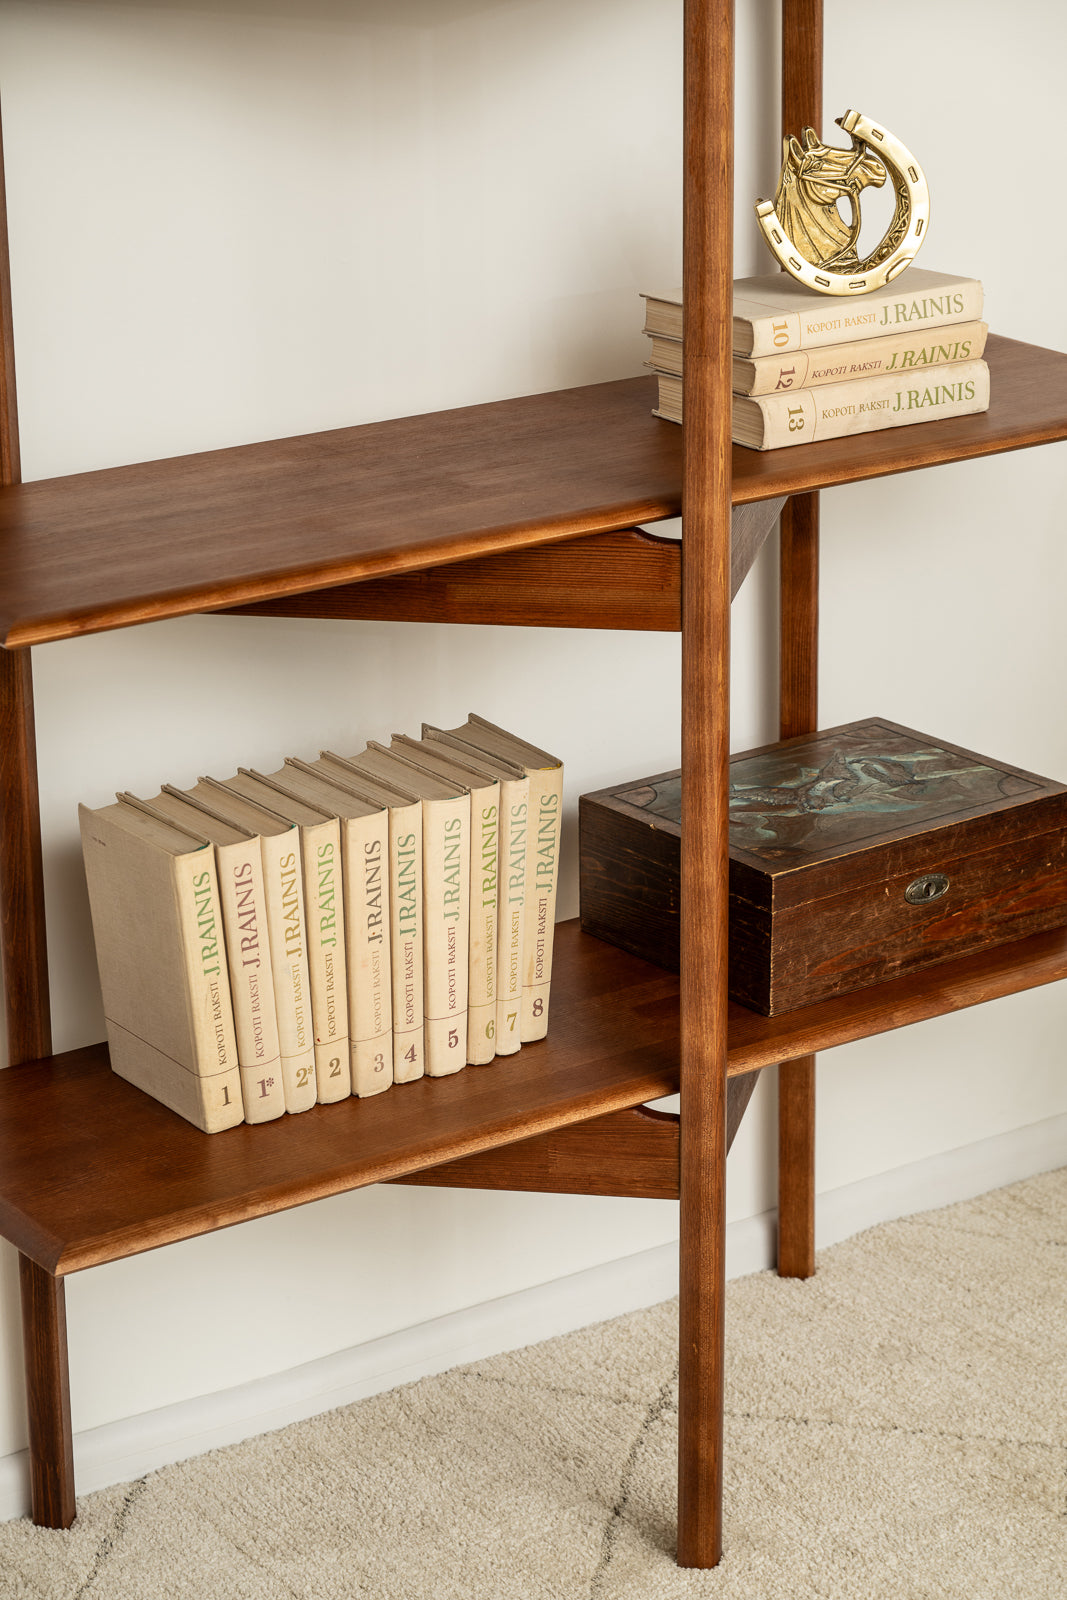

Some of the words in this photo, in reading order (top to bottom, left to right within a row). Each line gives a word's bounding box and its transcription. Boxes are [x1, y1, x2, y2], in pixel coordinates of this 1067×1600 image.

[807, 320, 842, 335] KOPOTI
[844, 313, 876, 327] RAKSTI
[880, 293, 964, 326] J.RAINIS
[771, 321, 790, 348] 10
[775, 366, 795, 390] 12
[811, 365, 847, 379] KOPOTI
[850, 360, 882, 372] RAKSTI
[886, 341, 972, 371] J.RAINIS
[787, 405, 805, 433] 13
[822, 405, 857, 419] KOPOTI
[858, 400, 890, 413] RAKSTI
[892, 380, 975, 412] J.RAINIS
[482, 806, 498, 909] J.RAINIS
[509, 803, 528, 906] J.RAINIS
[536, 793, 559, 893] J.RAINIS
[398, 833, 417, 938] J.RAINIS
[444, 818, 462, 921] J.RAINIS
[280, 852, 303, 958] J.RAINIS
[318, 842, 337, 947] J.RAINIS
[365, 840, 383, 944] J.RAINIS
[193, 871, 220, 977] J.RAINIS
[234, 862, 261, 968] J.RAINIS
[485, 915, 494, 954] RAKSTI
[511, 910, 520, 950] RAKSTI
[538, 898, 547, 937] RAKSTI
[404, 942, 413, 981] RAKSTI
[448, 927, 456, 965] RAKSTI
[536, 939, 546, 979] KOPOTI
[292, 964, 304, 1004] RAKSTI
[326, 953, 335, 993] RAKSTI
[372, 950, 381, 988] RAKSTI
[449, 968, 457, 1010] KOPOTI
[487, 956, 495, 998] KOPOTI
[509, 952, 518, 993] KOPOTI
[210, 981, 223, 1022] RAKSTI
[250, 975, 261, 1013] RAKSTI
[373, 991, 383, 1033] KOPOTI
[405, 983, 415, 1025] KOPOTI
[532, 998, 545, 1018] 8
[296, 1006, 306, 1048] KOPOTI
[328, 995, 337, 1037] KOPOTI
[485, 1020, 496, 1040] 6
[506, 1012, 518, 1032] 7
[213, 1024, 228, 1065] KOPOTI
[252, 1016, 265, 1058] KOPOTI
[404, 1044, 417, 1063] 4
[448, 1028, 459, 1049] 5
[329, 1057, 341, 1078] 2
[374, 1053, 384, 1073] 3
[221, 1085, 232, 1106] 1
